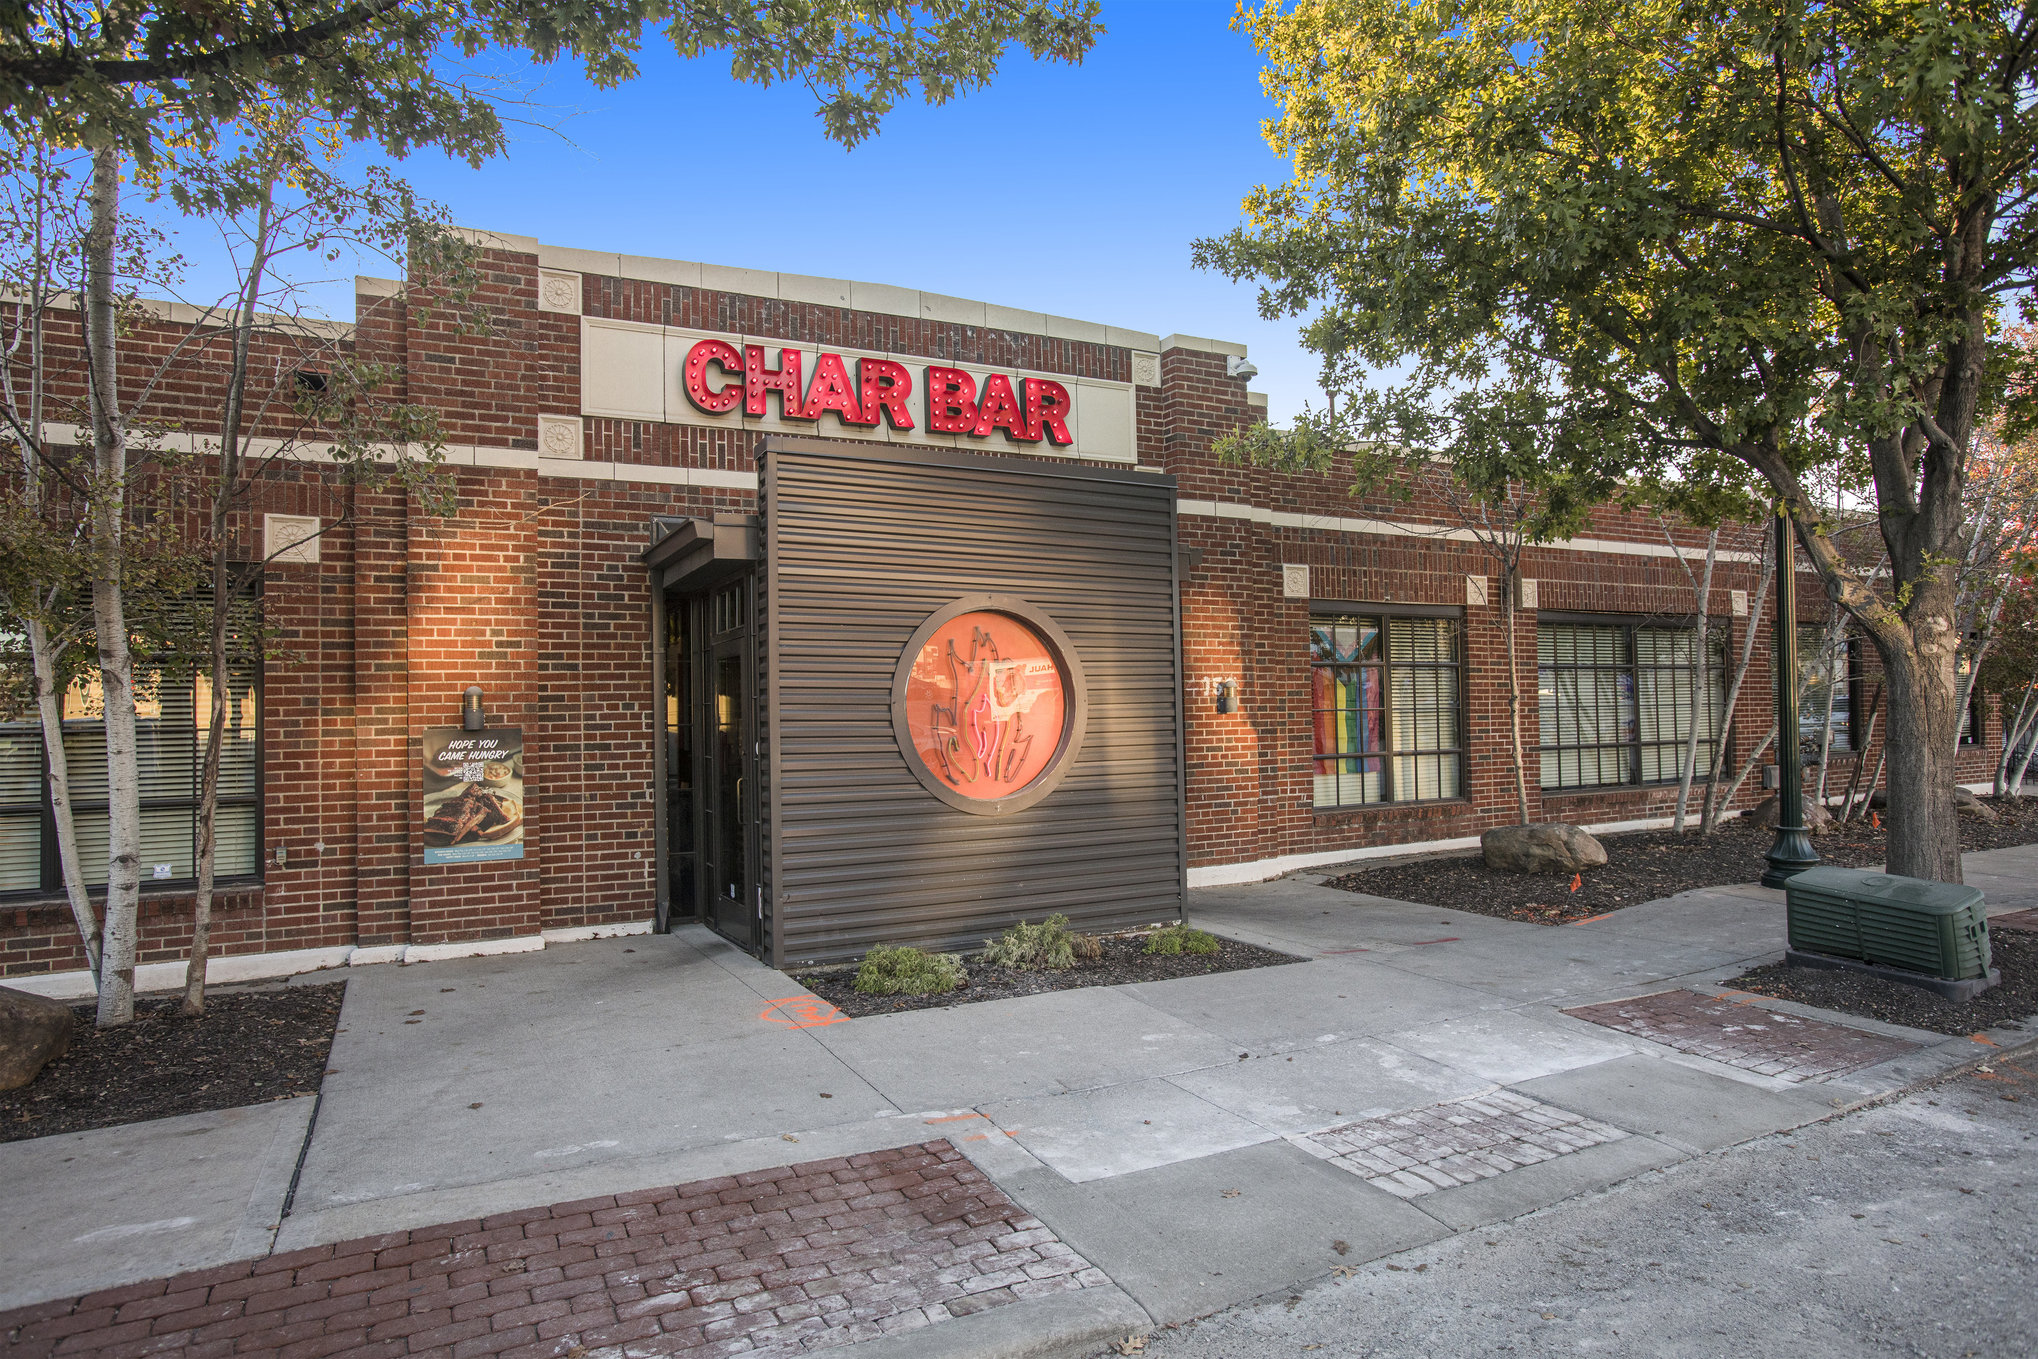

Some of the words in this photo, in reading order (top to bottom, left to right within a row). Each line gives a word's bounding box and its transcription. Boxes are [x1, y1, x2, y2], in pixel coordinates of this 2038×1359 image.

[682, 338, 915, 431] CHAR
[924, 365, 1074, 446] BAR
[448, 739, 476, 750] HOPE
[478, 739, 499, 749] YOU
[438, 751, 467, 761] CAME
[468, 750, 510, 760] HUNGRY
